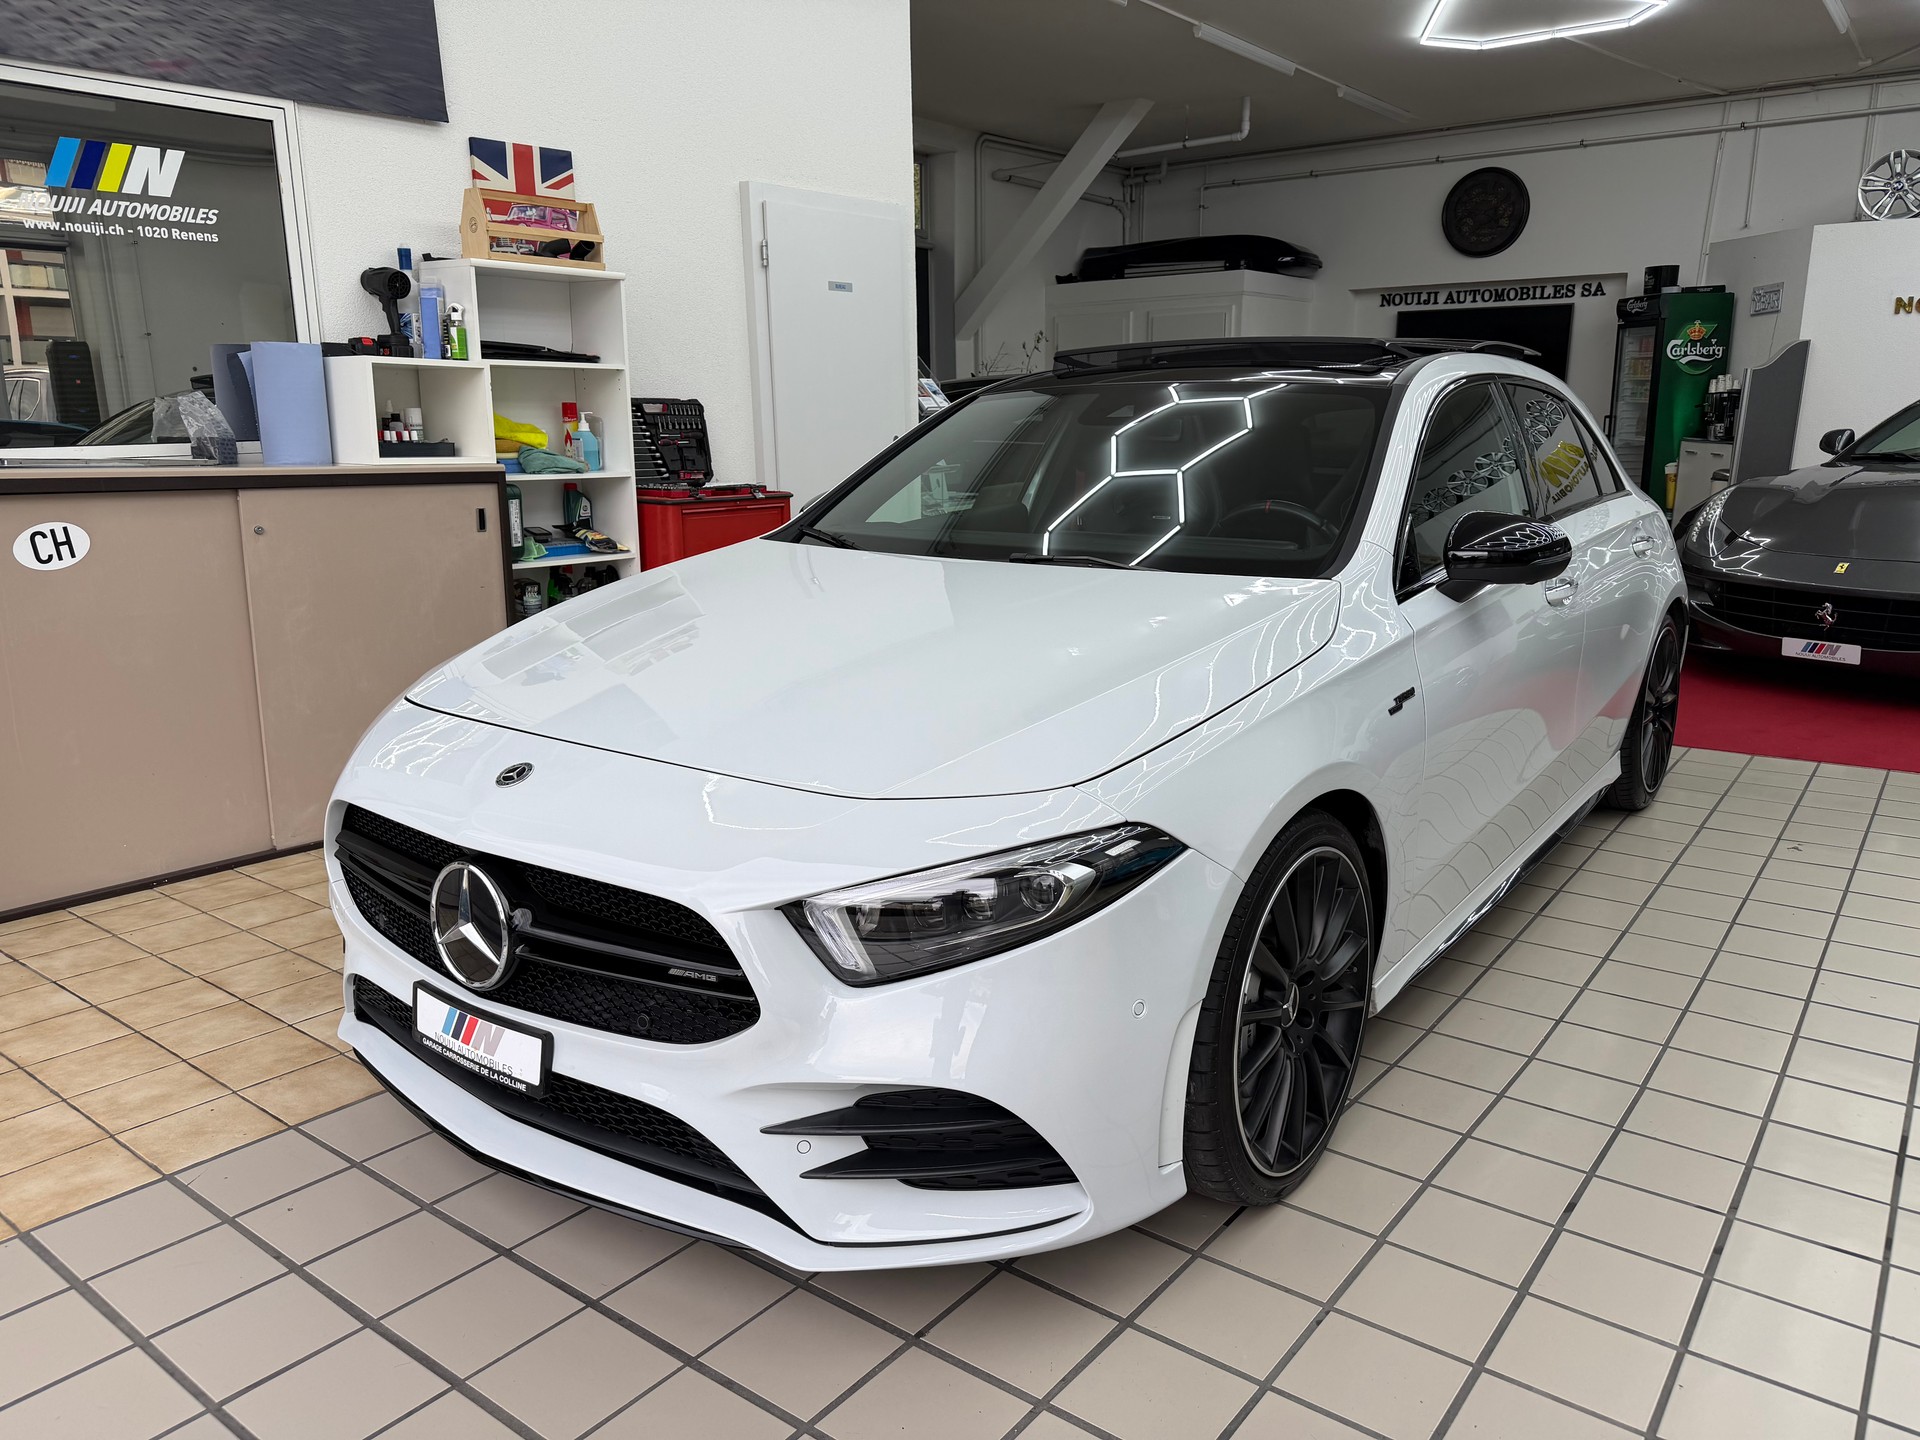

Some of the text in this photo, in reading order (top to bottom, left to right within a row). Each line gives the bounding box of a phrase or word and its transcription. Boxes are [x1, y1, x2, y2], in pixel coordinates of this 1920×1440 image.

[19, 192, 219, 225] NOUIJI AUTOMOBILES
[23, 218, 125, 236] www.nouiji.ch
[137, 226, 169, 239] 1020
[172, 229, 219, 243] Renens
[1379, 281, 1607, 307] NOUIJI AUTOMOBILES SA
[1627, 298, 1648, 312] Carlsberg
[1666, 338, 1724, 360] Carlsberg
[29, 525, 77, 565] CH
[682, 970, 718, 982] AMG
[422, 1037, 527, 1092] GARAGE CARROSSERIE DE LA COLLINE
[434, 1031, 514, 1077] NOUIJI AUTOMOBILES
